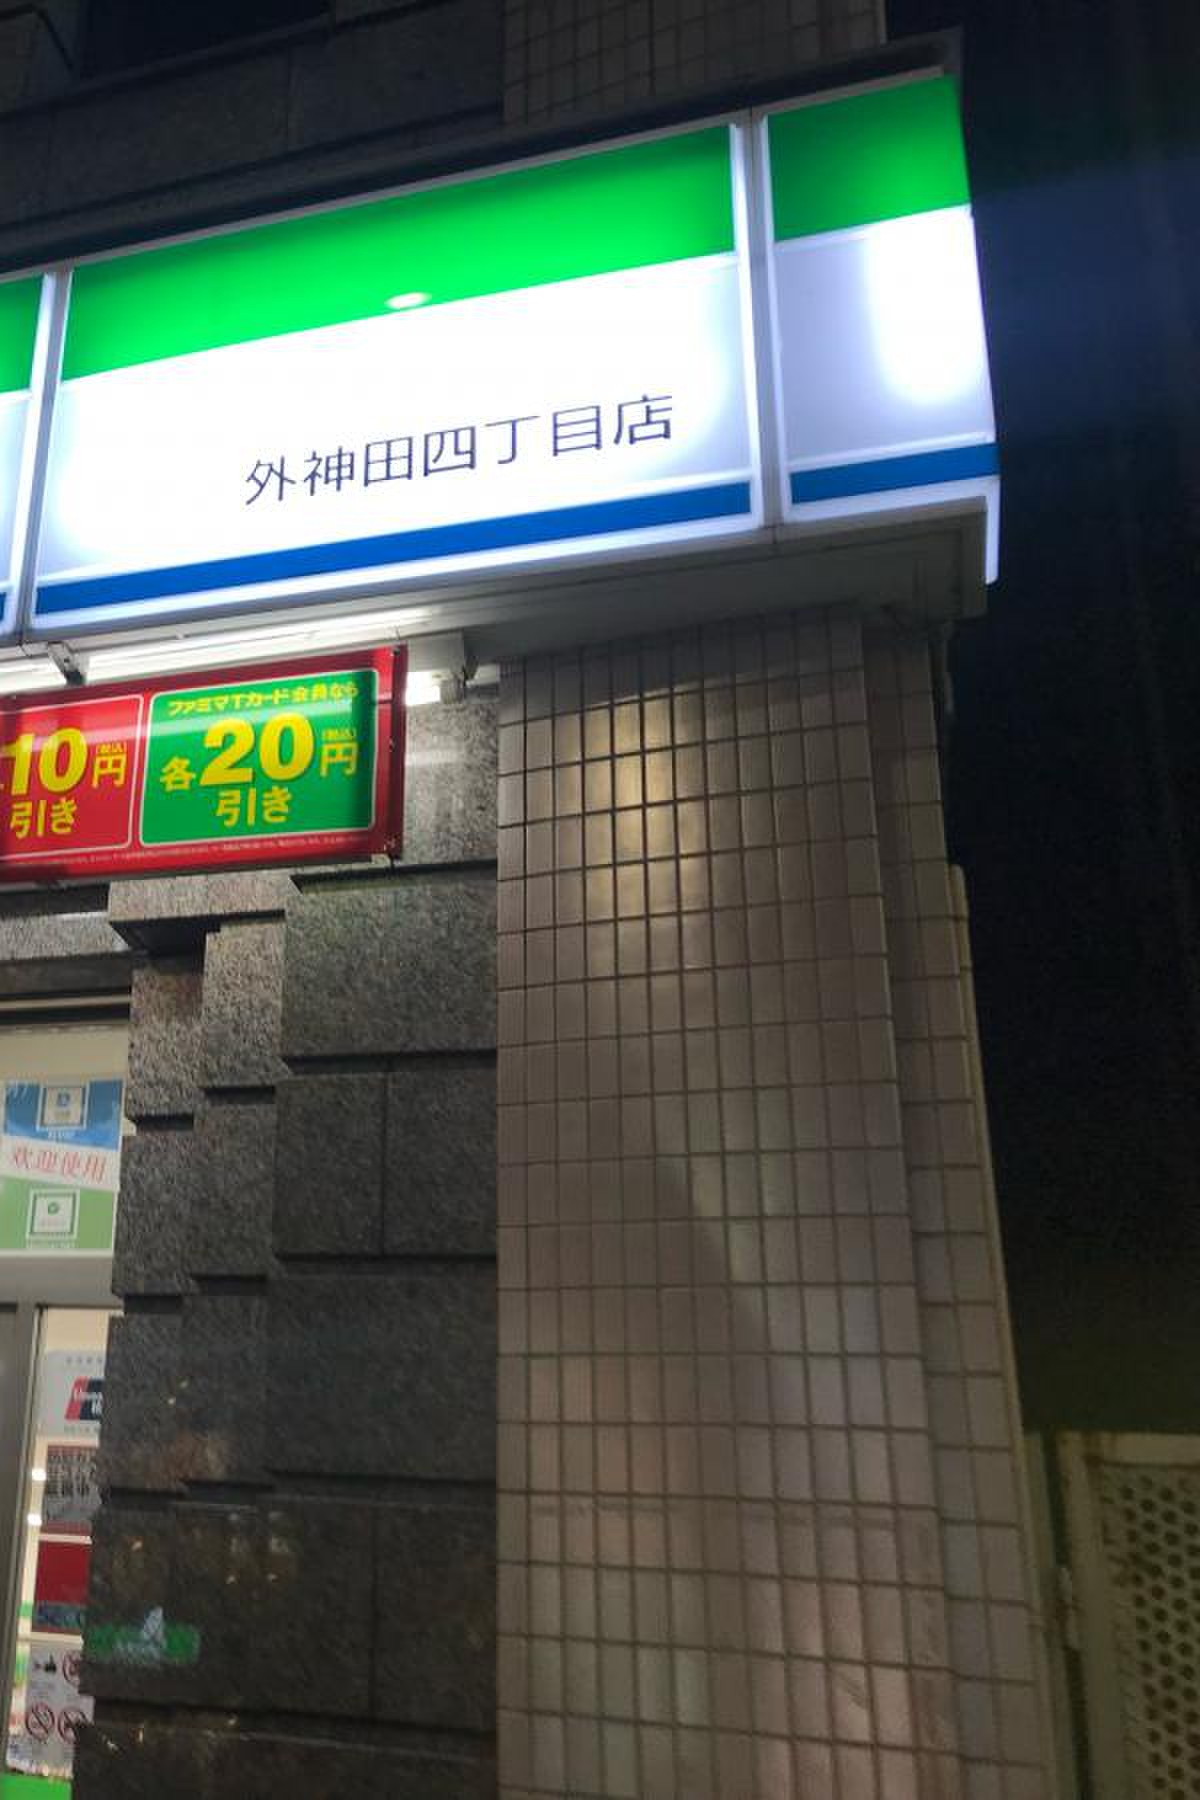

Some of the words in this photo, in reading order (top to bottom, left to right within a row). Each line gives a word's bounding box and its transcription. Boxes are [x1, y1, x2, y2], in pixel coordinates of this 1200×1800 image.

[244, 394, 673, 505] 外神田四丁目店
[9, 797, 78, 839] 引き
[215, 785, 292, 827] 引き
